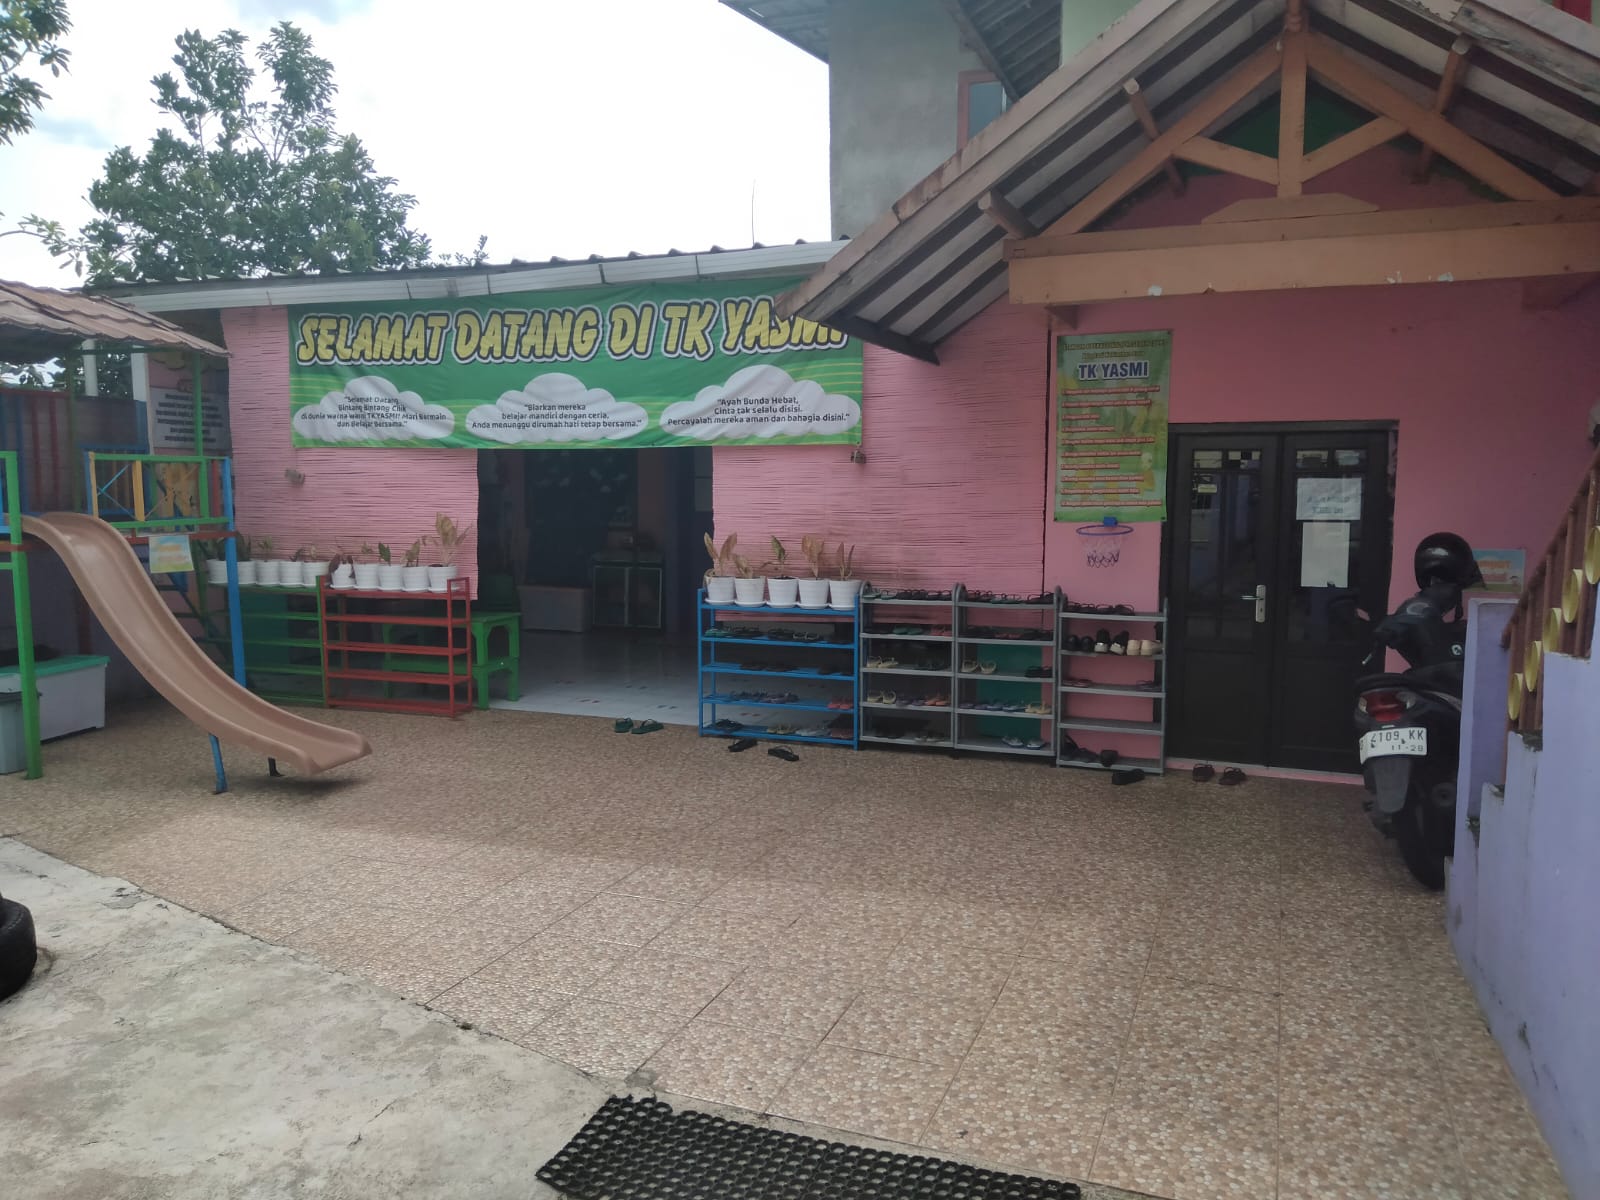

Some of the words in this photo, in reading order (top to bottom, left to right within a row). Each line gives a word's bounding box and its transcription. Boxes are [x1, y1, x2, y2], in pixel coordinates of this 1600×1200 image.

[296, 313, 450, 364] SELAMAT
[453, 308, 602, 363] DATANG
[607, 302, 657, 359] DI
[662, 299, 717, 360] TK
[1079, 364, 1097, 379] TK
[1101, 361, 1148, 378] YASMI
[374, 396, 399, 404] Datang
[743, 397, 769, 405] Bunda
[338, 404, 363, 412] Bintang
[363, 404, 390, 413] Bintang
[557, 403, 586, 411] mereka
[402, 412, 418, 420] Mari
[502, 412, 527, 421] belajar
[529, 412, 558, 420] mandiri
[559, 412, 587, 421] dengan
[668, 417, 712, 426] Percayalah
[713, 416, 743, 424] mereka
[771, 415, 786, 423] dan
[787, 414, 821, 424] bahagia
[337, 420, 350, 428] dan
[472, 421, 491, 429] Anda
[491, 421, 530, 430] menunggu
[531, 420, 563, 428] dirumah
[564, 420, 579, 428] hati
[580, 420, 601, 430] tetap
[1408, 729, 1424, 741] KK
